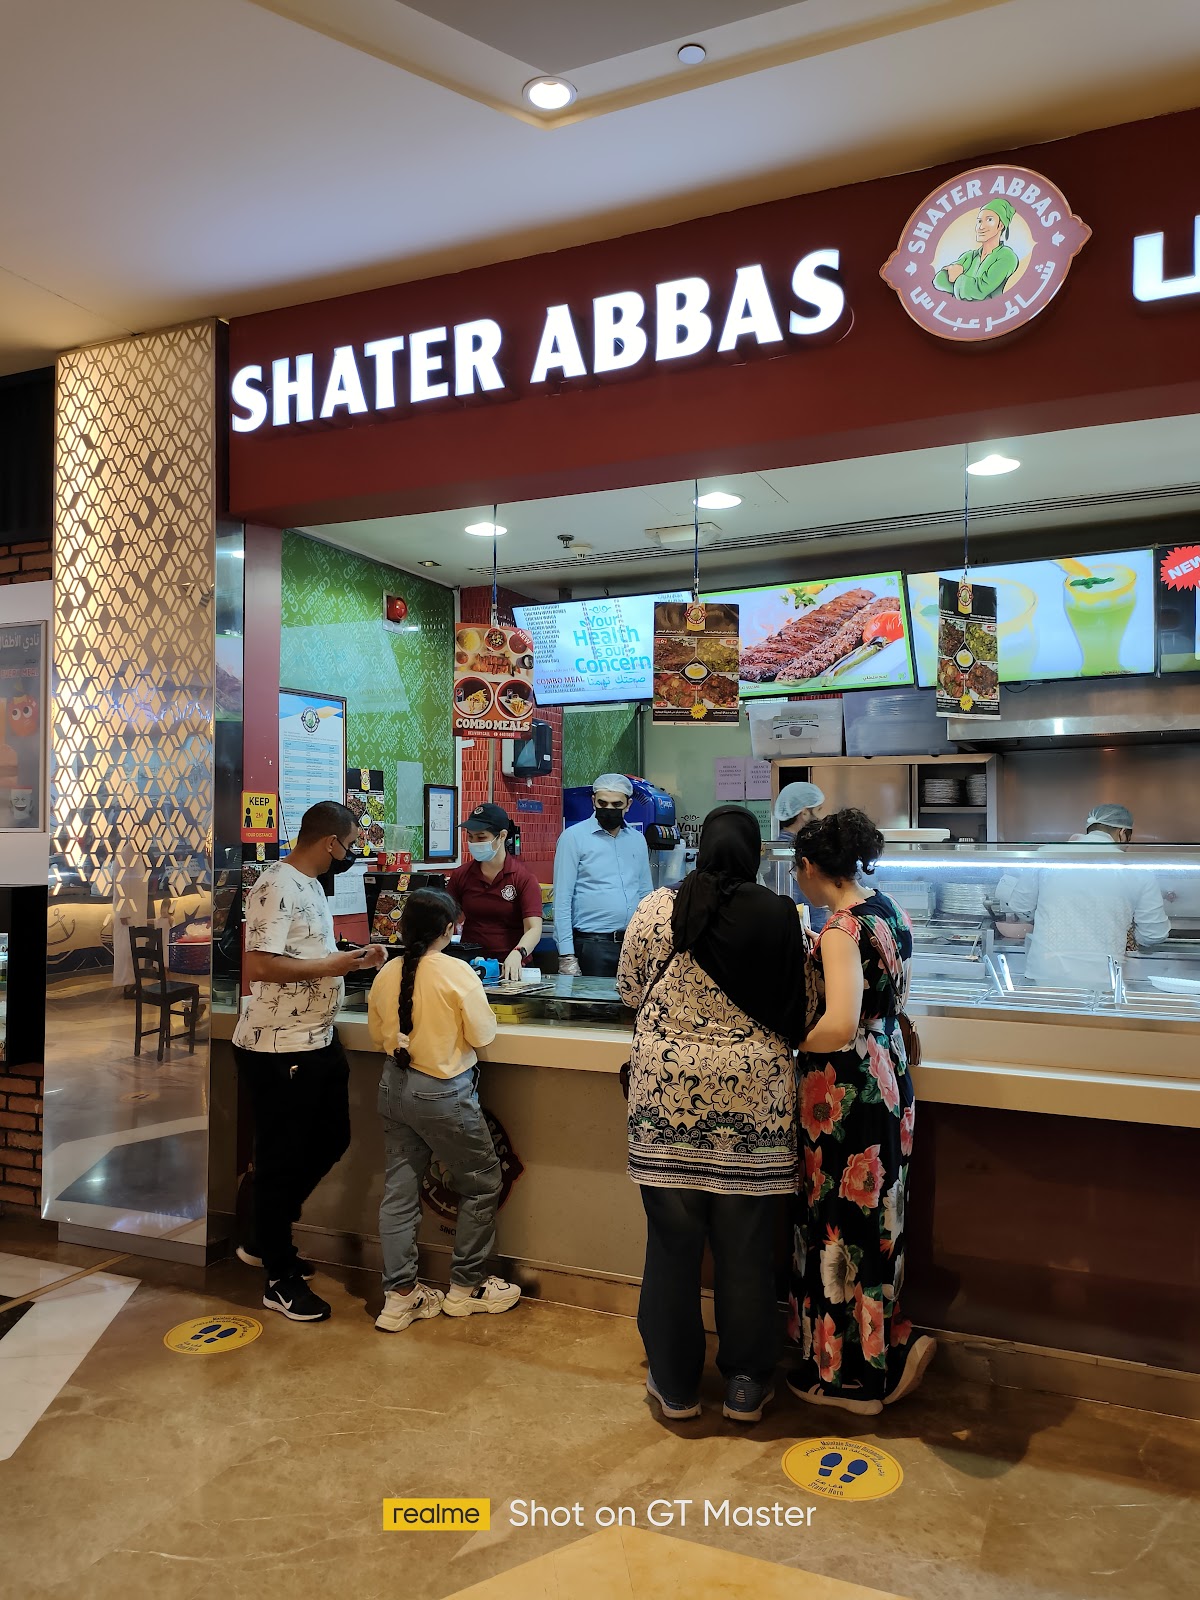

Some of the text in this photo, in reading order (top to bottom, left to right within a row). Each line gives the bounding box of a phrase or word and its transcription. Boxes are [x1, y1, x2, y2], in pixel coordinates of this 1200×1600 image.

[908, 175, 1061, 254] SHATER ABBAS
[231, 248, 848, 434] SHATER ABBAS
[588, 615, 617, 627] Your
[22, 633, 40, 652] نادي
[517, 629, 532, 645] NEW
[573, 625, 640, 646] Health
[575, 655, 652, 674] Concern
[536, 675, 585, 685] COMBO MEAL
[455, 718, 531, 732] COMBO MEALS
[248, 796, 270, 806] KEEP
[678, 822, 704, 833] Your
[807, 1482, 827, 1493] Stand
